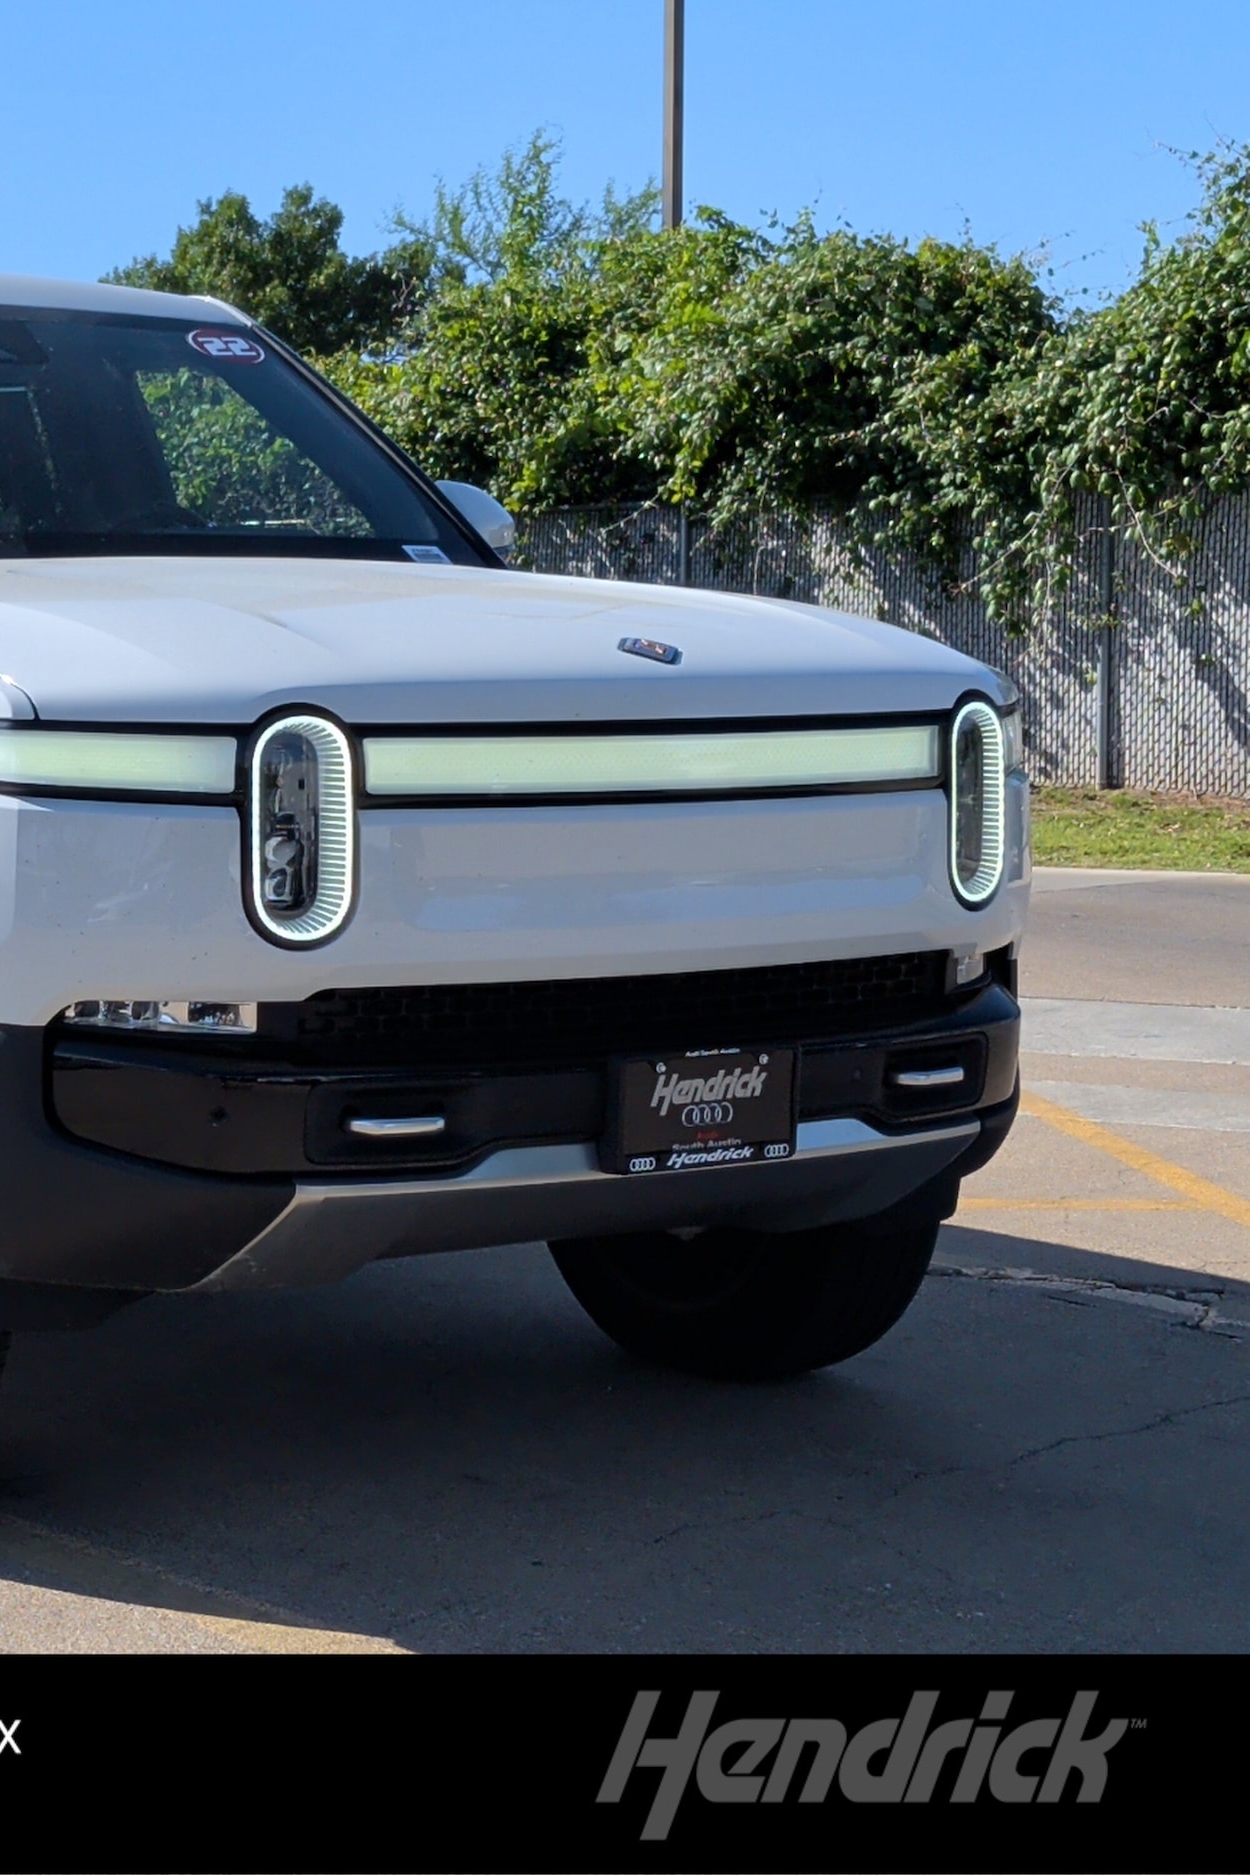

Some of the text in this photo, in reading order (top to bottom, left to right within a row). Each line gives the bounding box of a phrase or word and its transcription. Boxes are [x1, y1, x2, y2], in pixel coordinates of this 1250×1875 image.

[197, 336, 257, 356] 22
[650, 1065, 768, 1116] Hendrick
[666, 1146, 754, 1169] Hendrick
